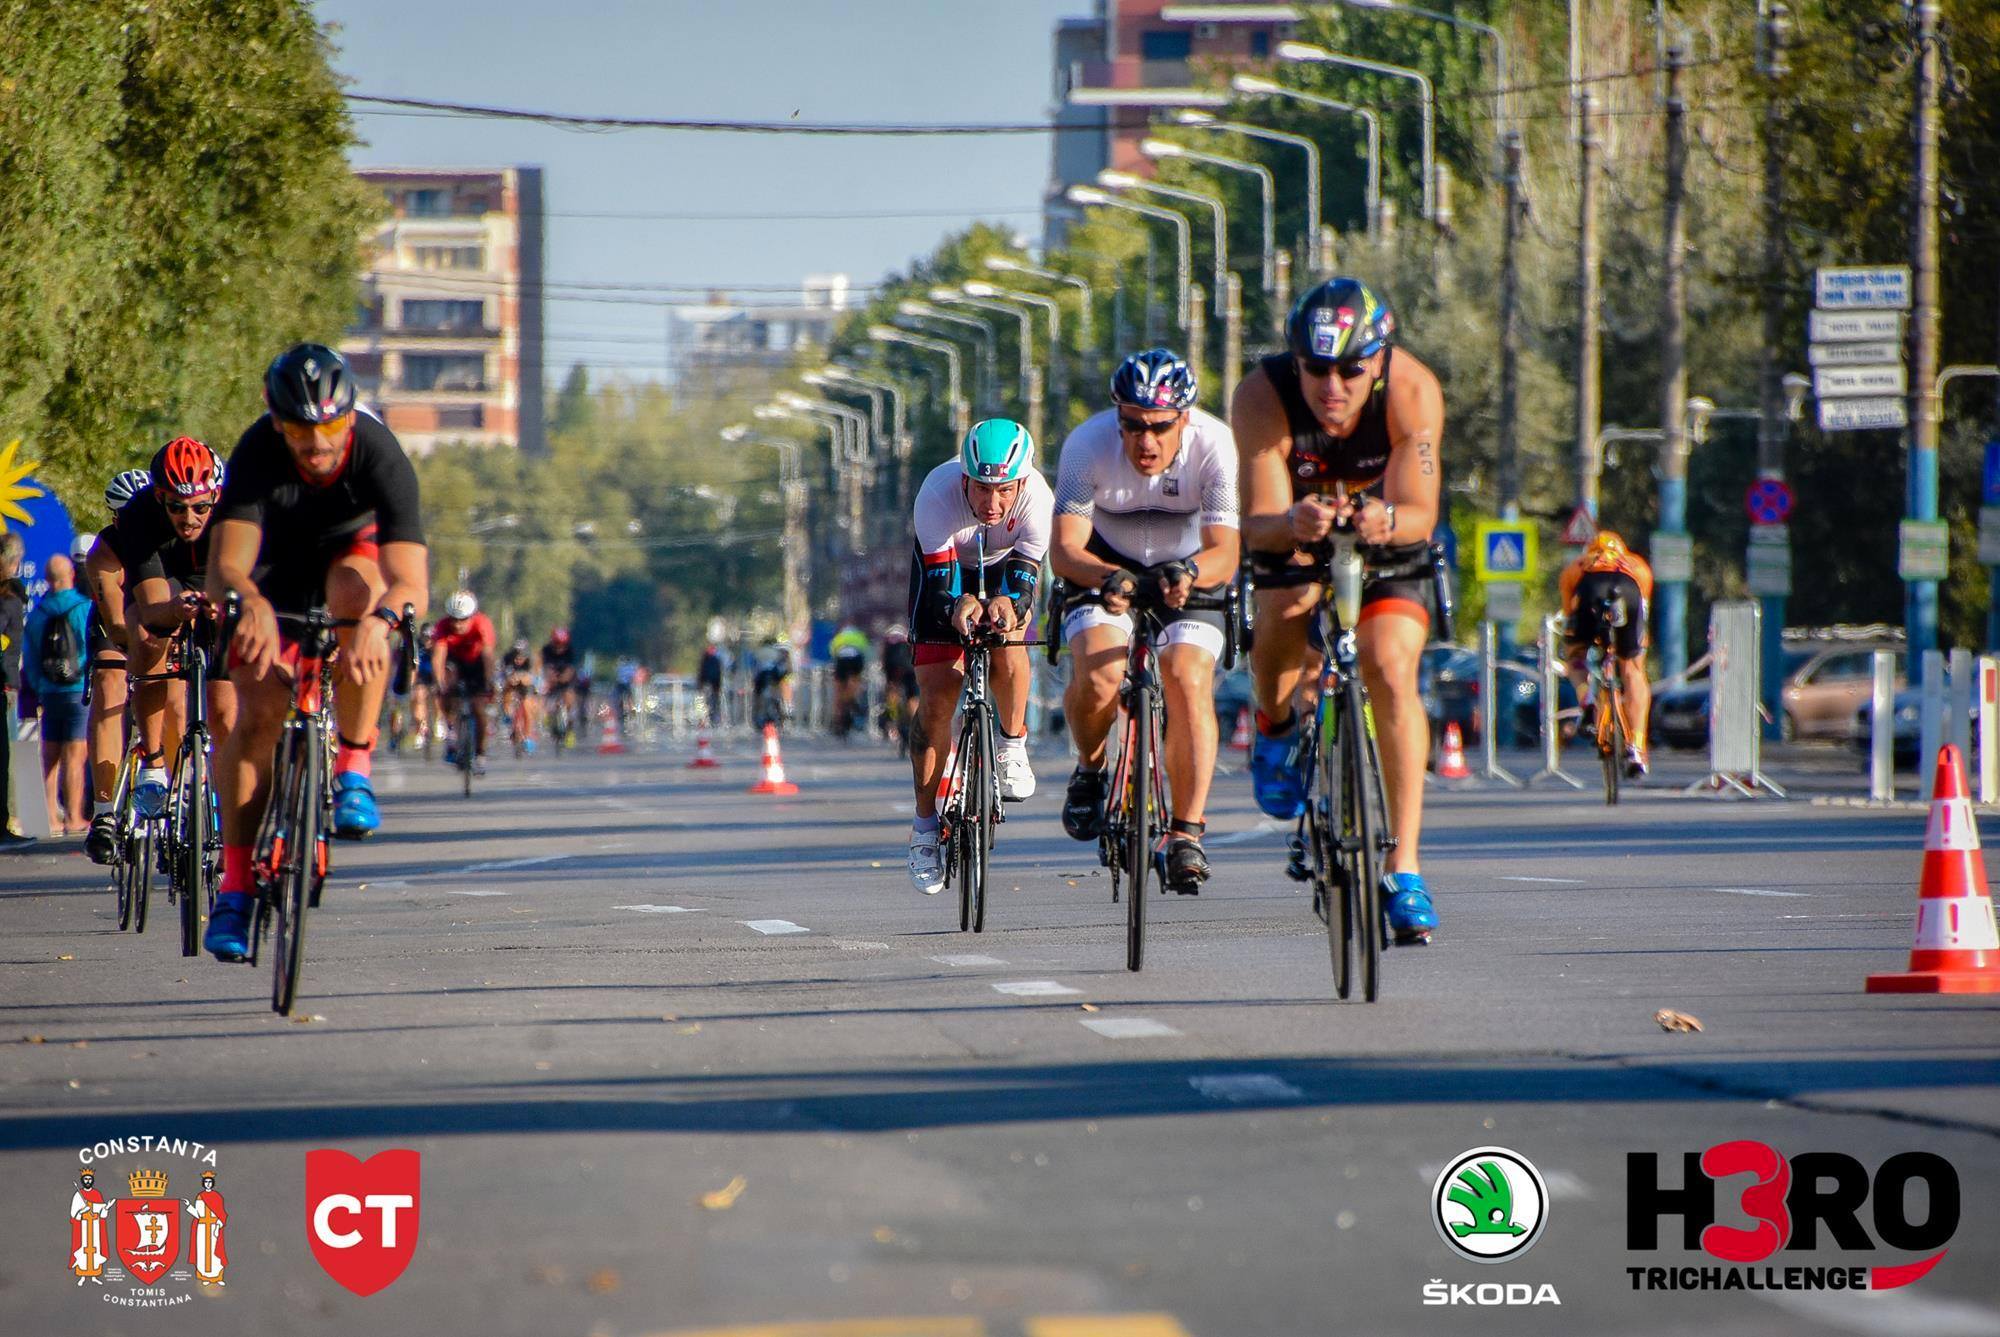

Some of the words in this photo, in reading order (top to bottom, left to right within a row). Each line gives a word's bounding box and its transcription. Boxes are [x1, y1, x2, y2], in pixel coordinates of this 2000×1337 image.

[984, 465, 991, 475] 3
[927, 568, 950, 578] FIT
[1013, 569, 1038, 586] TEC
